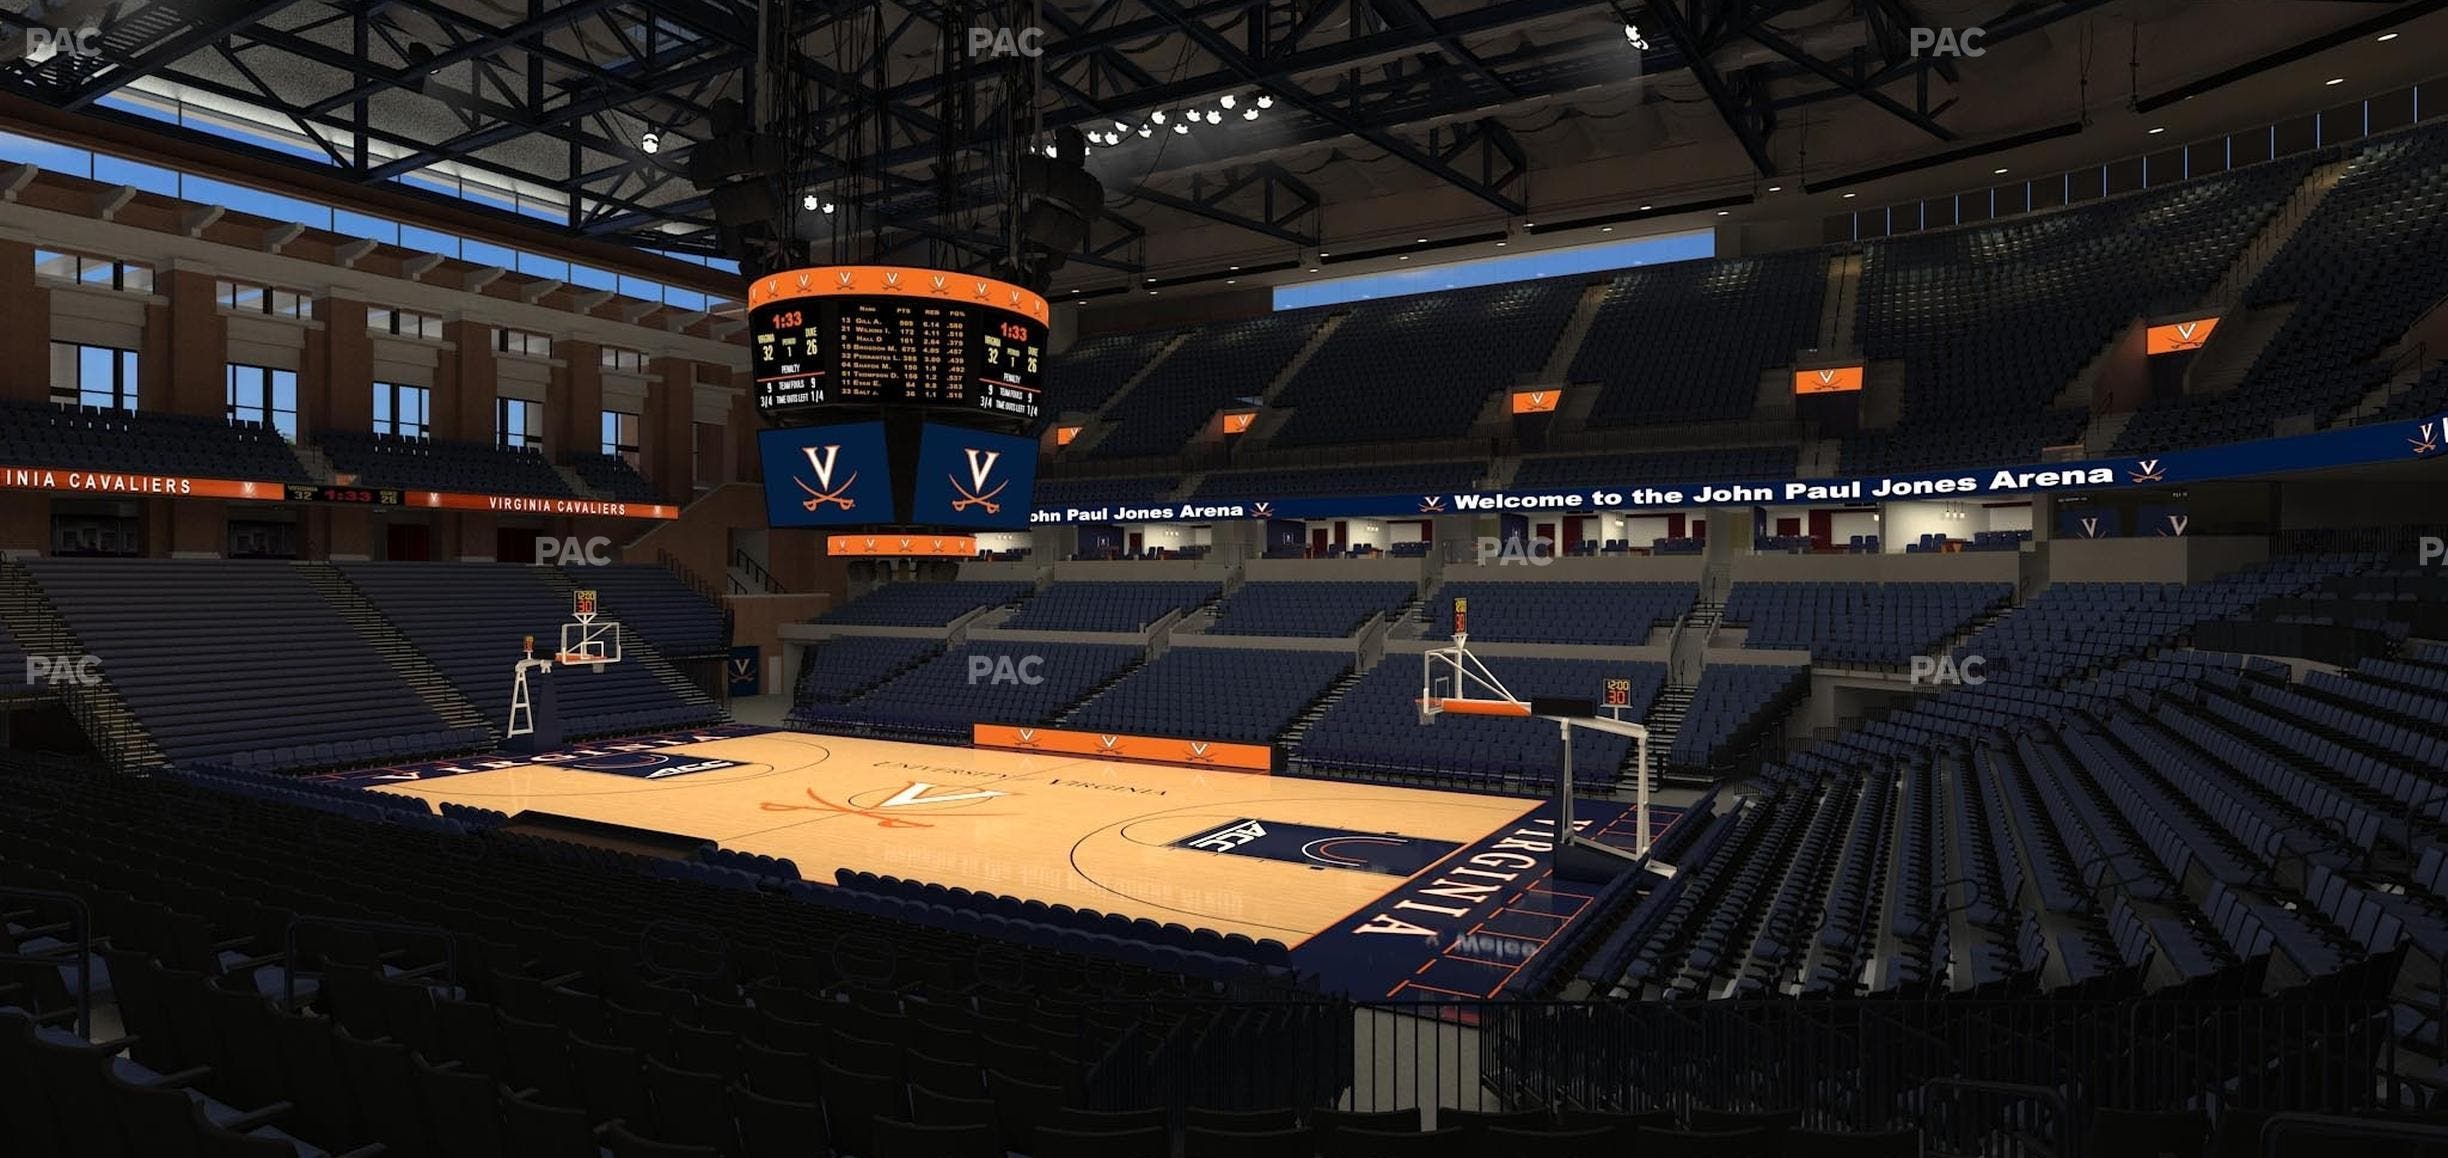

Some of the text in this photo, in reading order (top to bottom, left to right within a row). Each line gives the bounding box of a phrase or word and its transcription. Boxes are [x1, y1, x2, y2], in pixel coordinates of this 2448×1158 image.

[773, 311, 802, 329] 1:33
[1001, 322, 1027, 342] 1:33
[763, 339, 818, 361] 32 1 26
[988, 347, 999, 364] 32
[1028, 357, 1038, 373] 26
[767, 382, 773, 393] 9
[810, 378, 816, 388] 9
[760, 395, 773, 408] 3/4
[811, 390, 824, 403] 1/4
[980, 396, 992, 408] 3/4
[1027, 405, 1038, 417] 1/4
[6, 470, 191, 494] INIA CAVALIERS
[1454, 466, 2114, 510] Welcome to the John Paul Jones Arena
[294, 491, 312, 500] 32
[324, 490, 372, 502] 1:33
[489, 497, 625, 515] VIRGINIA CAVALIERS
[1067, 508, 1107, 522] Paul
[1114, 506, 1173, 520] Jones
[1180, 504, 1243, 518] Arena
[1608, 690, 1625, 704] 30
[1049, 778, 1167, 797] VIRGINIA
[1352, 819, 1594, 937] VIRGINIA
